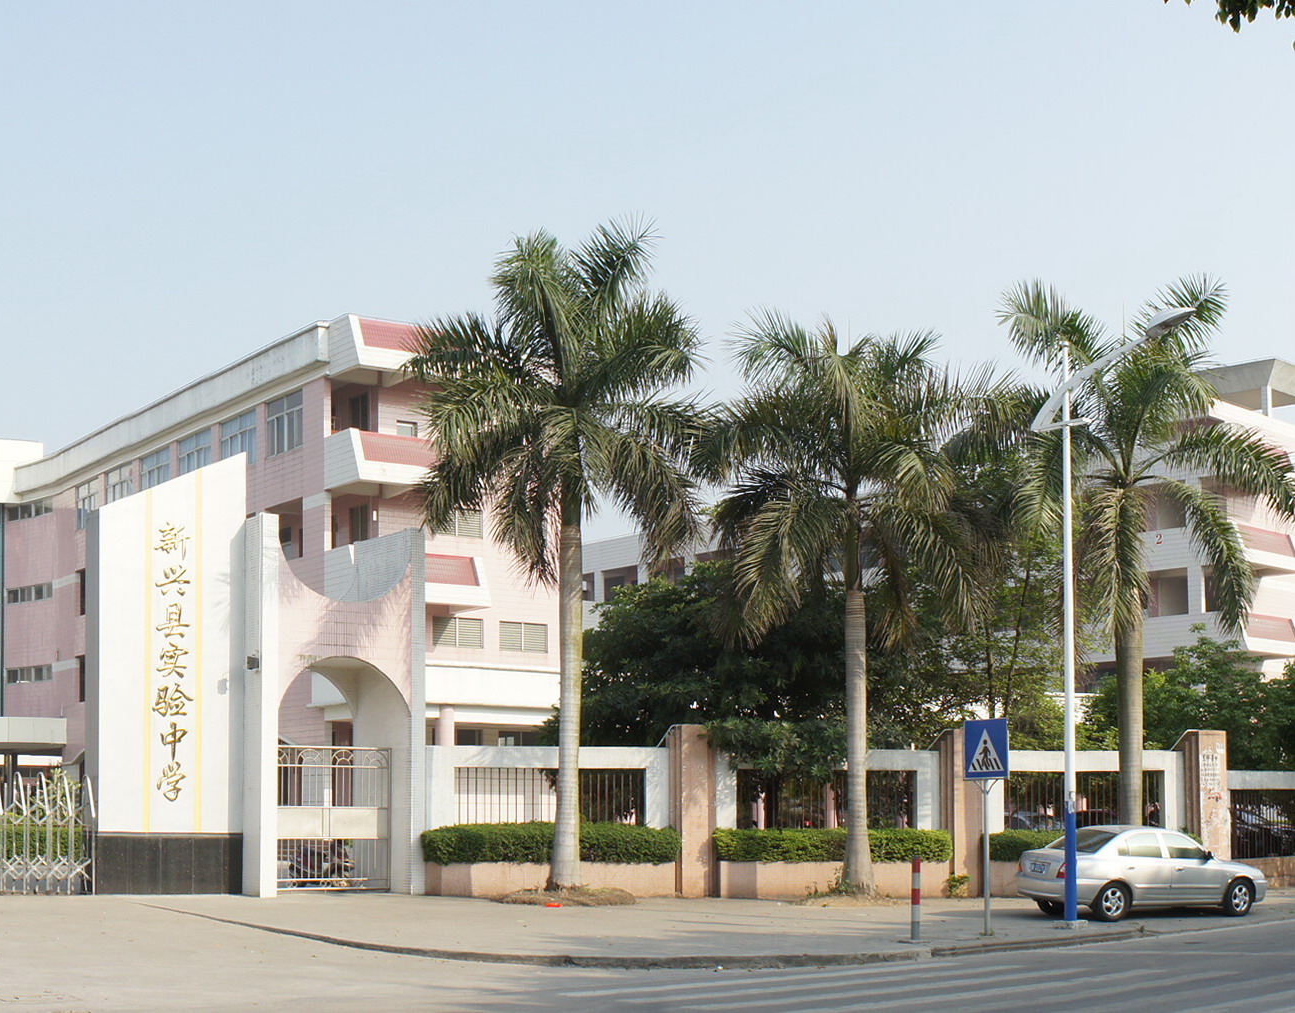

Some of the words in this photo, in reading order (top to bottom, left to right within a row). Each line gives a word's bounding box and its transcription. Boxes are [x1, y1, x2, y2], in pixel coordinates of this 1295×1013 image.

[1155, 534, 1163, 544] 2
[152, 521, 194, 802] 新兴县实验中学
